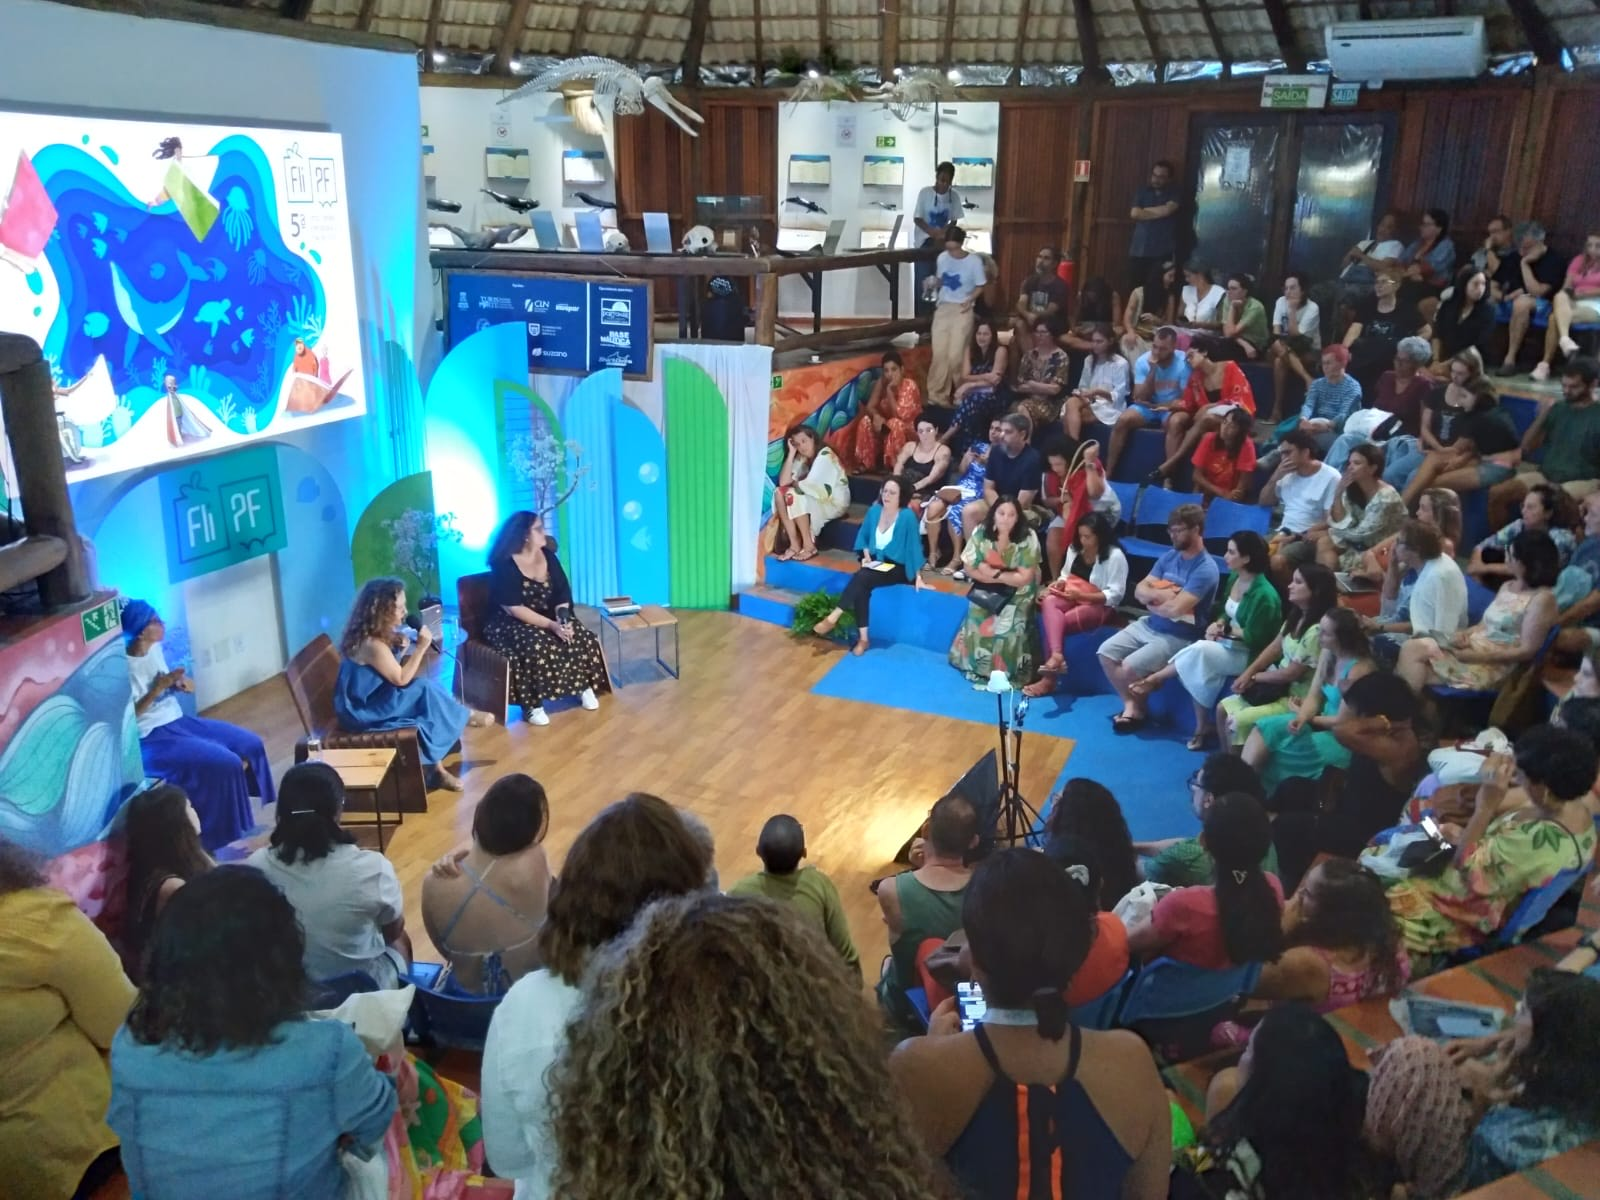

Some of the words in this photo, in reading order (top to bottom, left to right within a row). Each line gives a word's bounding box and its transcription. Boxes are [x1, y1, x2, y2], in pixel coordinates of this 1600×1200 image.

[1273, 88, 1306, 101] SAÍDA
[290, 165, 306, 193] Fli
[534, 299, 550, 308] CLN
[543, 350, 568, 358] suzano
[187, 502, 216, 548] Fli
